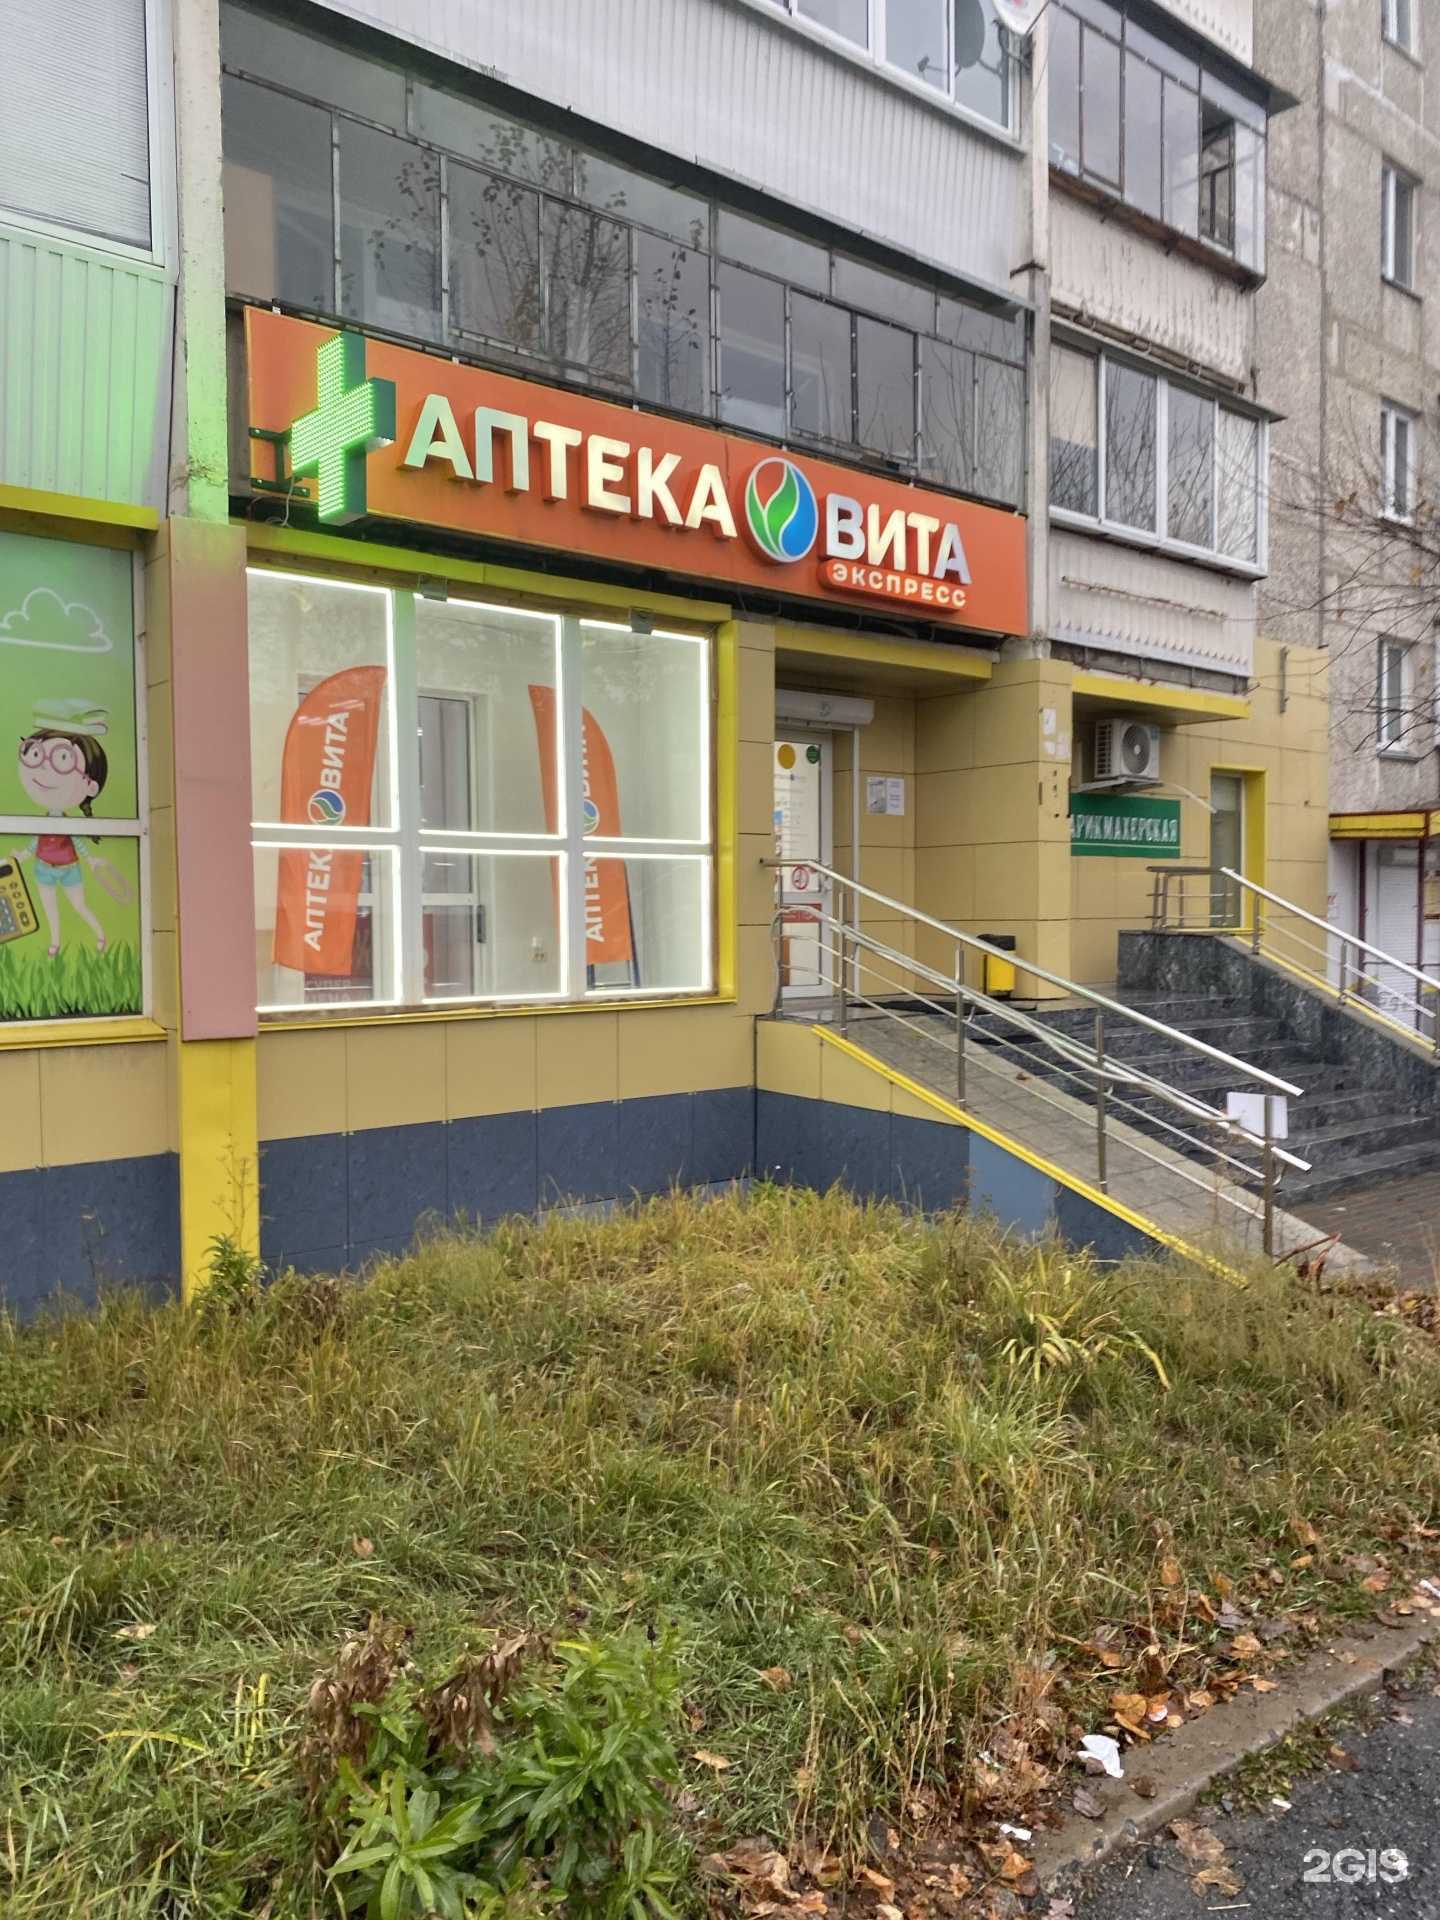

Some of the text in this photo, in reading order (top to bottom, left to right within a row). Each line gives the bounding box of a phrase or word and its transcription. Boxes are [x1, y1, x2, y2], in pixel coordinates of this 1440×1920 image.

[402, 393, 973, 585] АПТЕКА ВИТА
[832, 562, 967, 608] ЭКСПРЕСС
[303, 848, 334, 952] АПТЕК
[319, 710, 350, 790] ВИТА
[1070, 813, 1177, 843] АРИКМАХЕРСКАЯ
[583, 856, 606, 943] АПТЕК
